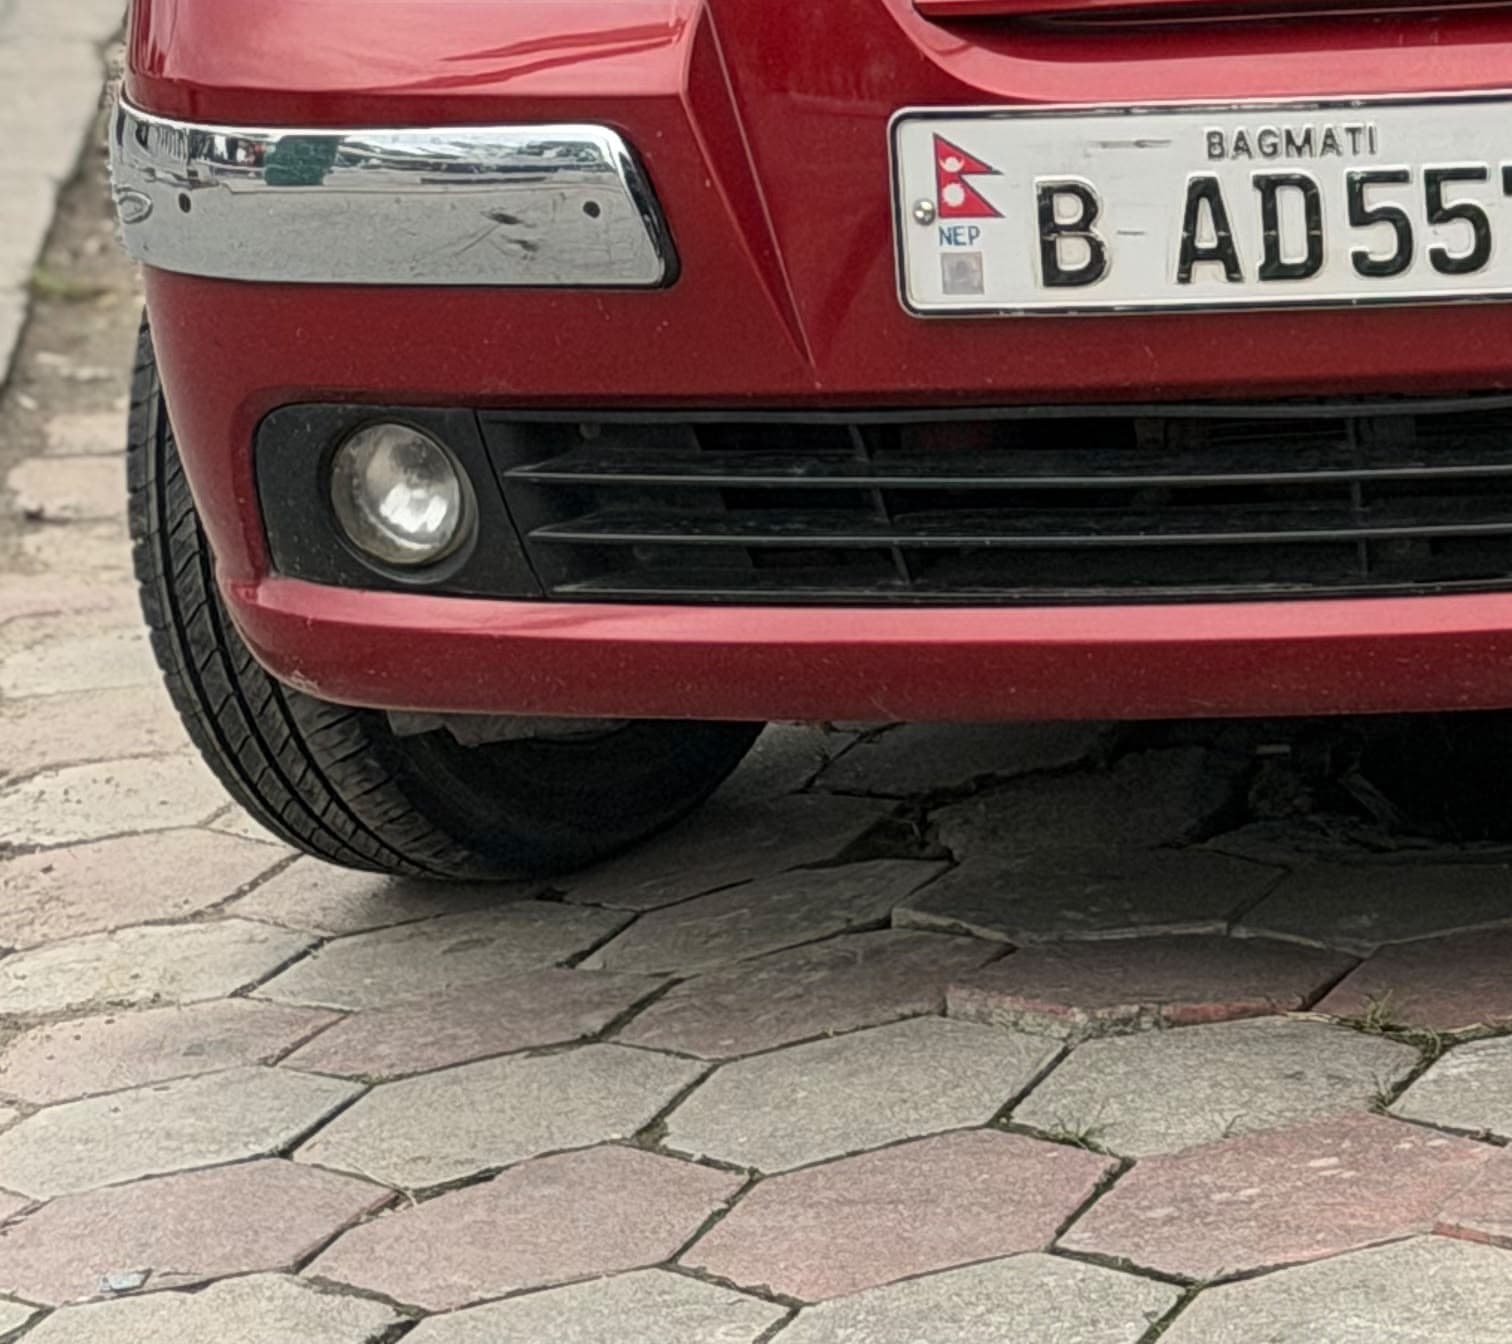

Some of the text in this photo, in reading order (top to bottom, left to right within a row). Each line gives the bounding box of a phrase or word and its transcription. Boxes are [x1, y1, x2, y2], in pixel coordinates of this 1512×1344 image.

[1206, 124, 1379, 161] BAGMATI
[938, 225, 981, 247] NEP
[1033, 179, 1109, 289] B
